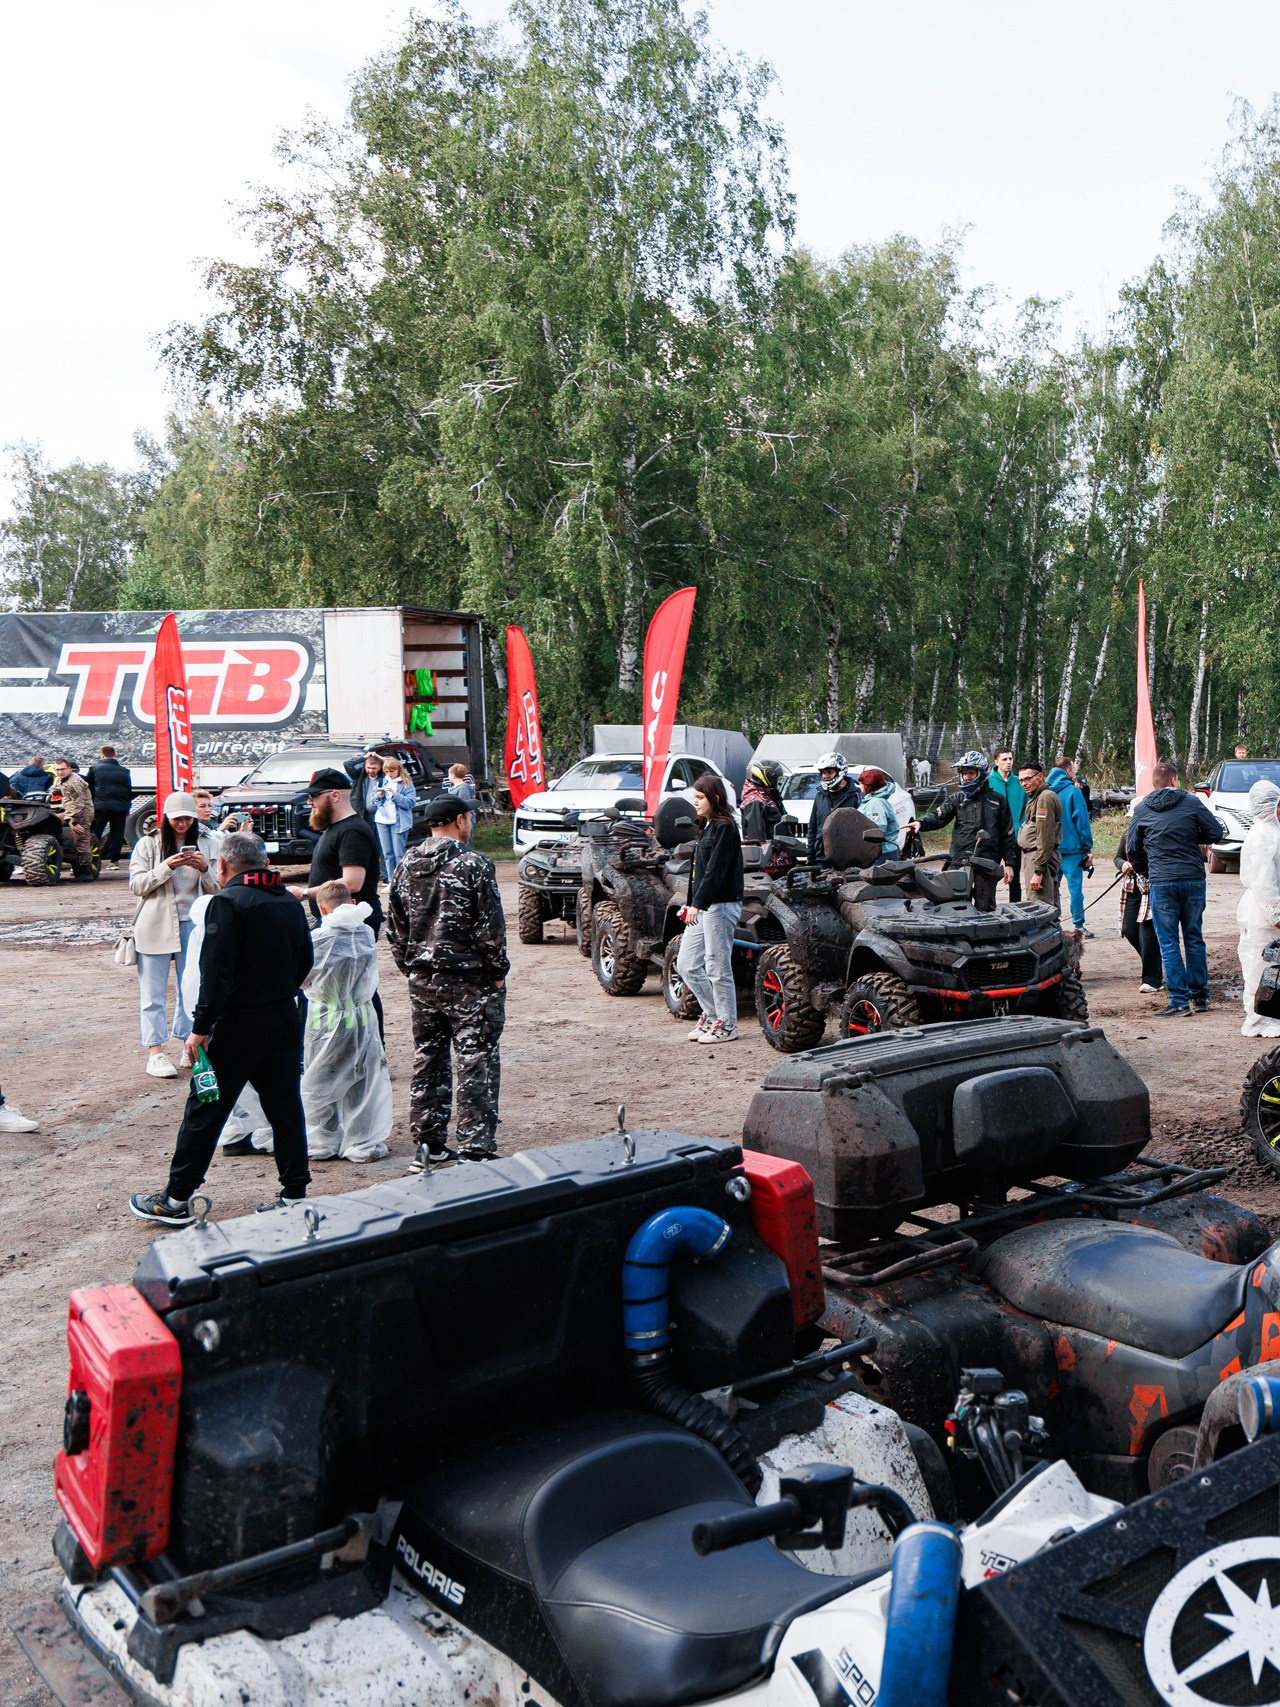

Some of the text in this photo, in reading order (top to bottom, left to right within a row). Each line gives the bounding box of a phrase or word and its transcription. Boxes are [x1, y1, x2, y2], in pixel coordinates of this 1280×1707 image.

[52, 637, 313, 729] TGB
[167, 684, 190, 792] TGB
[195, 741, 287, 754] different
[990, 962, 1009, 970] TGB
[396, 1533, 466, 1605] POLARIS
[834, 1646, 880, 1707] SPO
